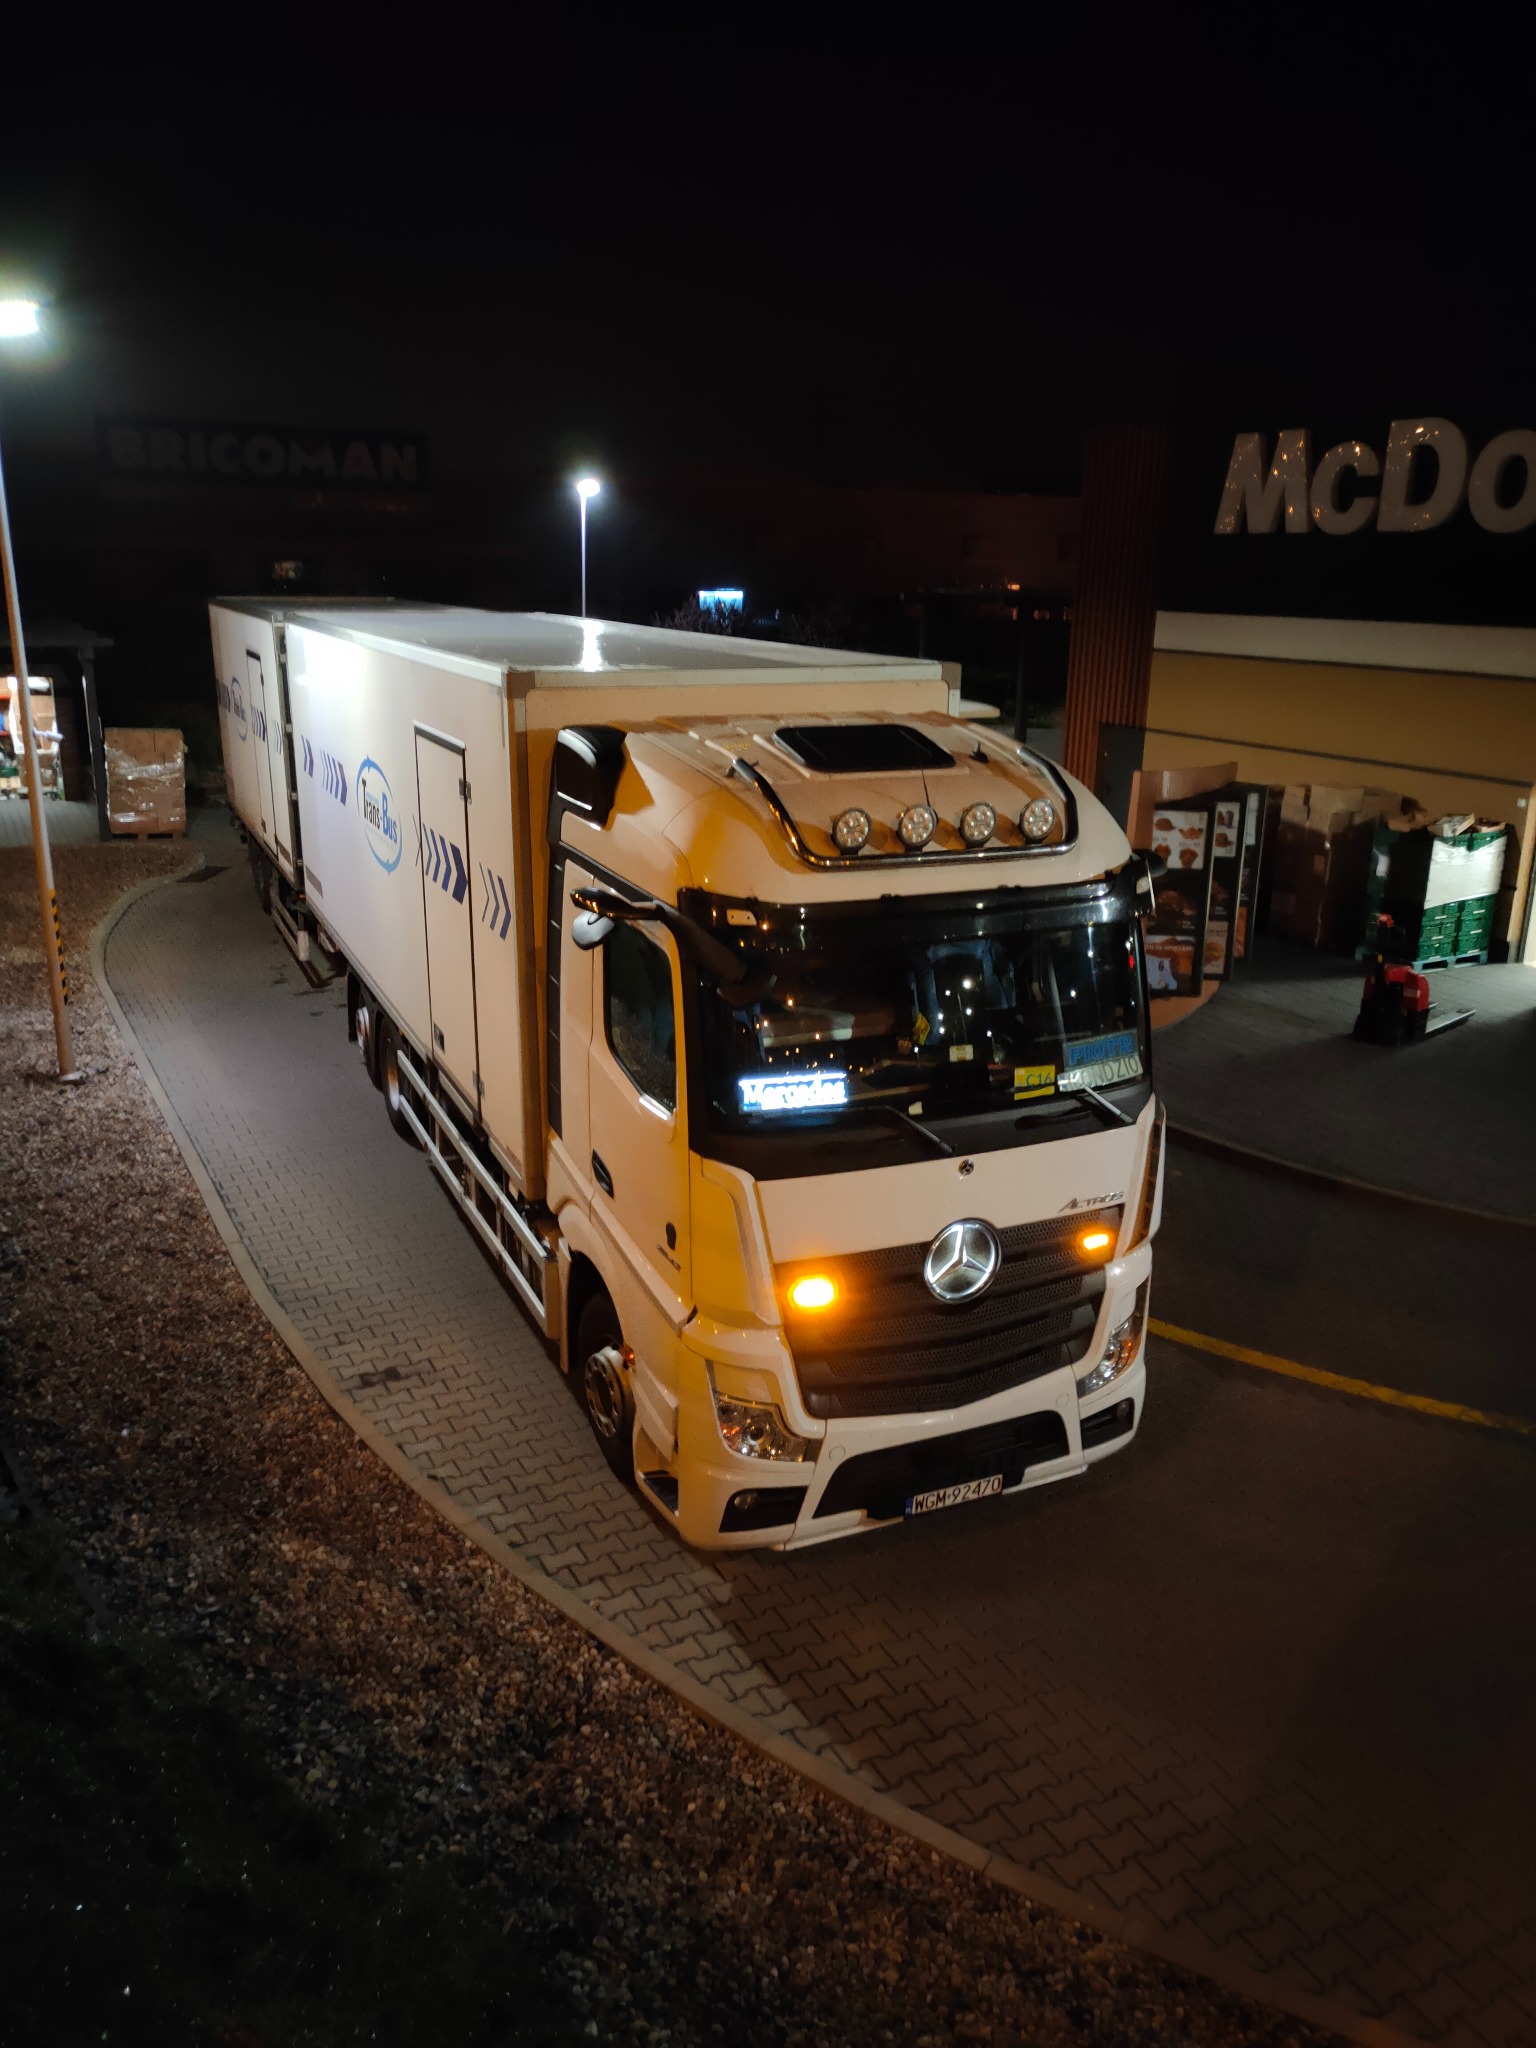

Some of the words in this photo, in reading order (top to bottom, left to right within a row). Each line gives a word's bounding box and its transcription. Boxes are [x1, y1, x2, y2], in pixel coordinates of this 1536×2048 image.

[108, 427, 417, 483] BRICOMAN
[361, 777, 398, 845] Trans-Bus
[1068, 1034, 1134, 1065] PIOTR
[741, 1076, 846, 1108] Mercedes
